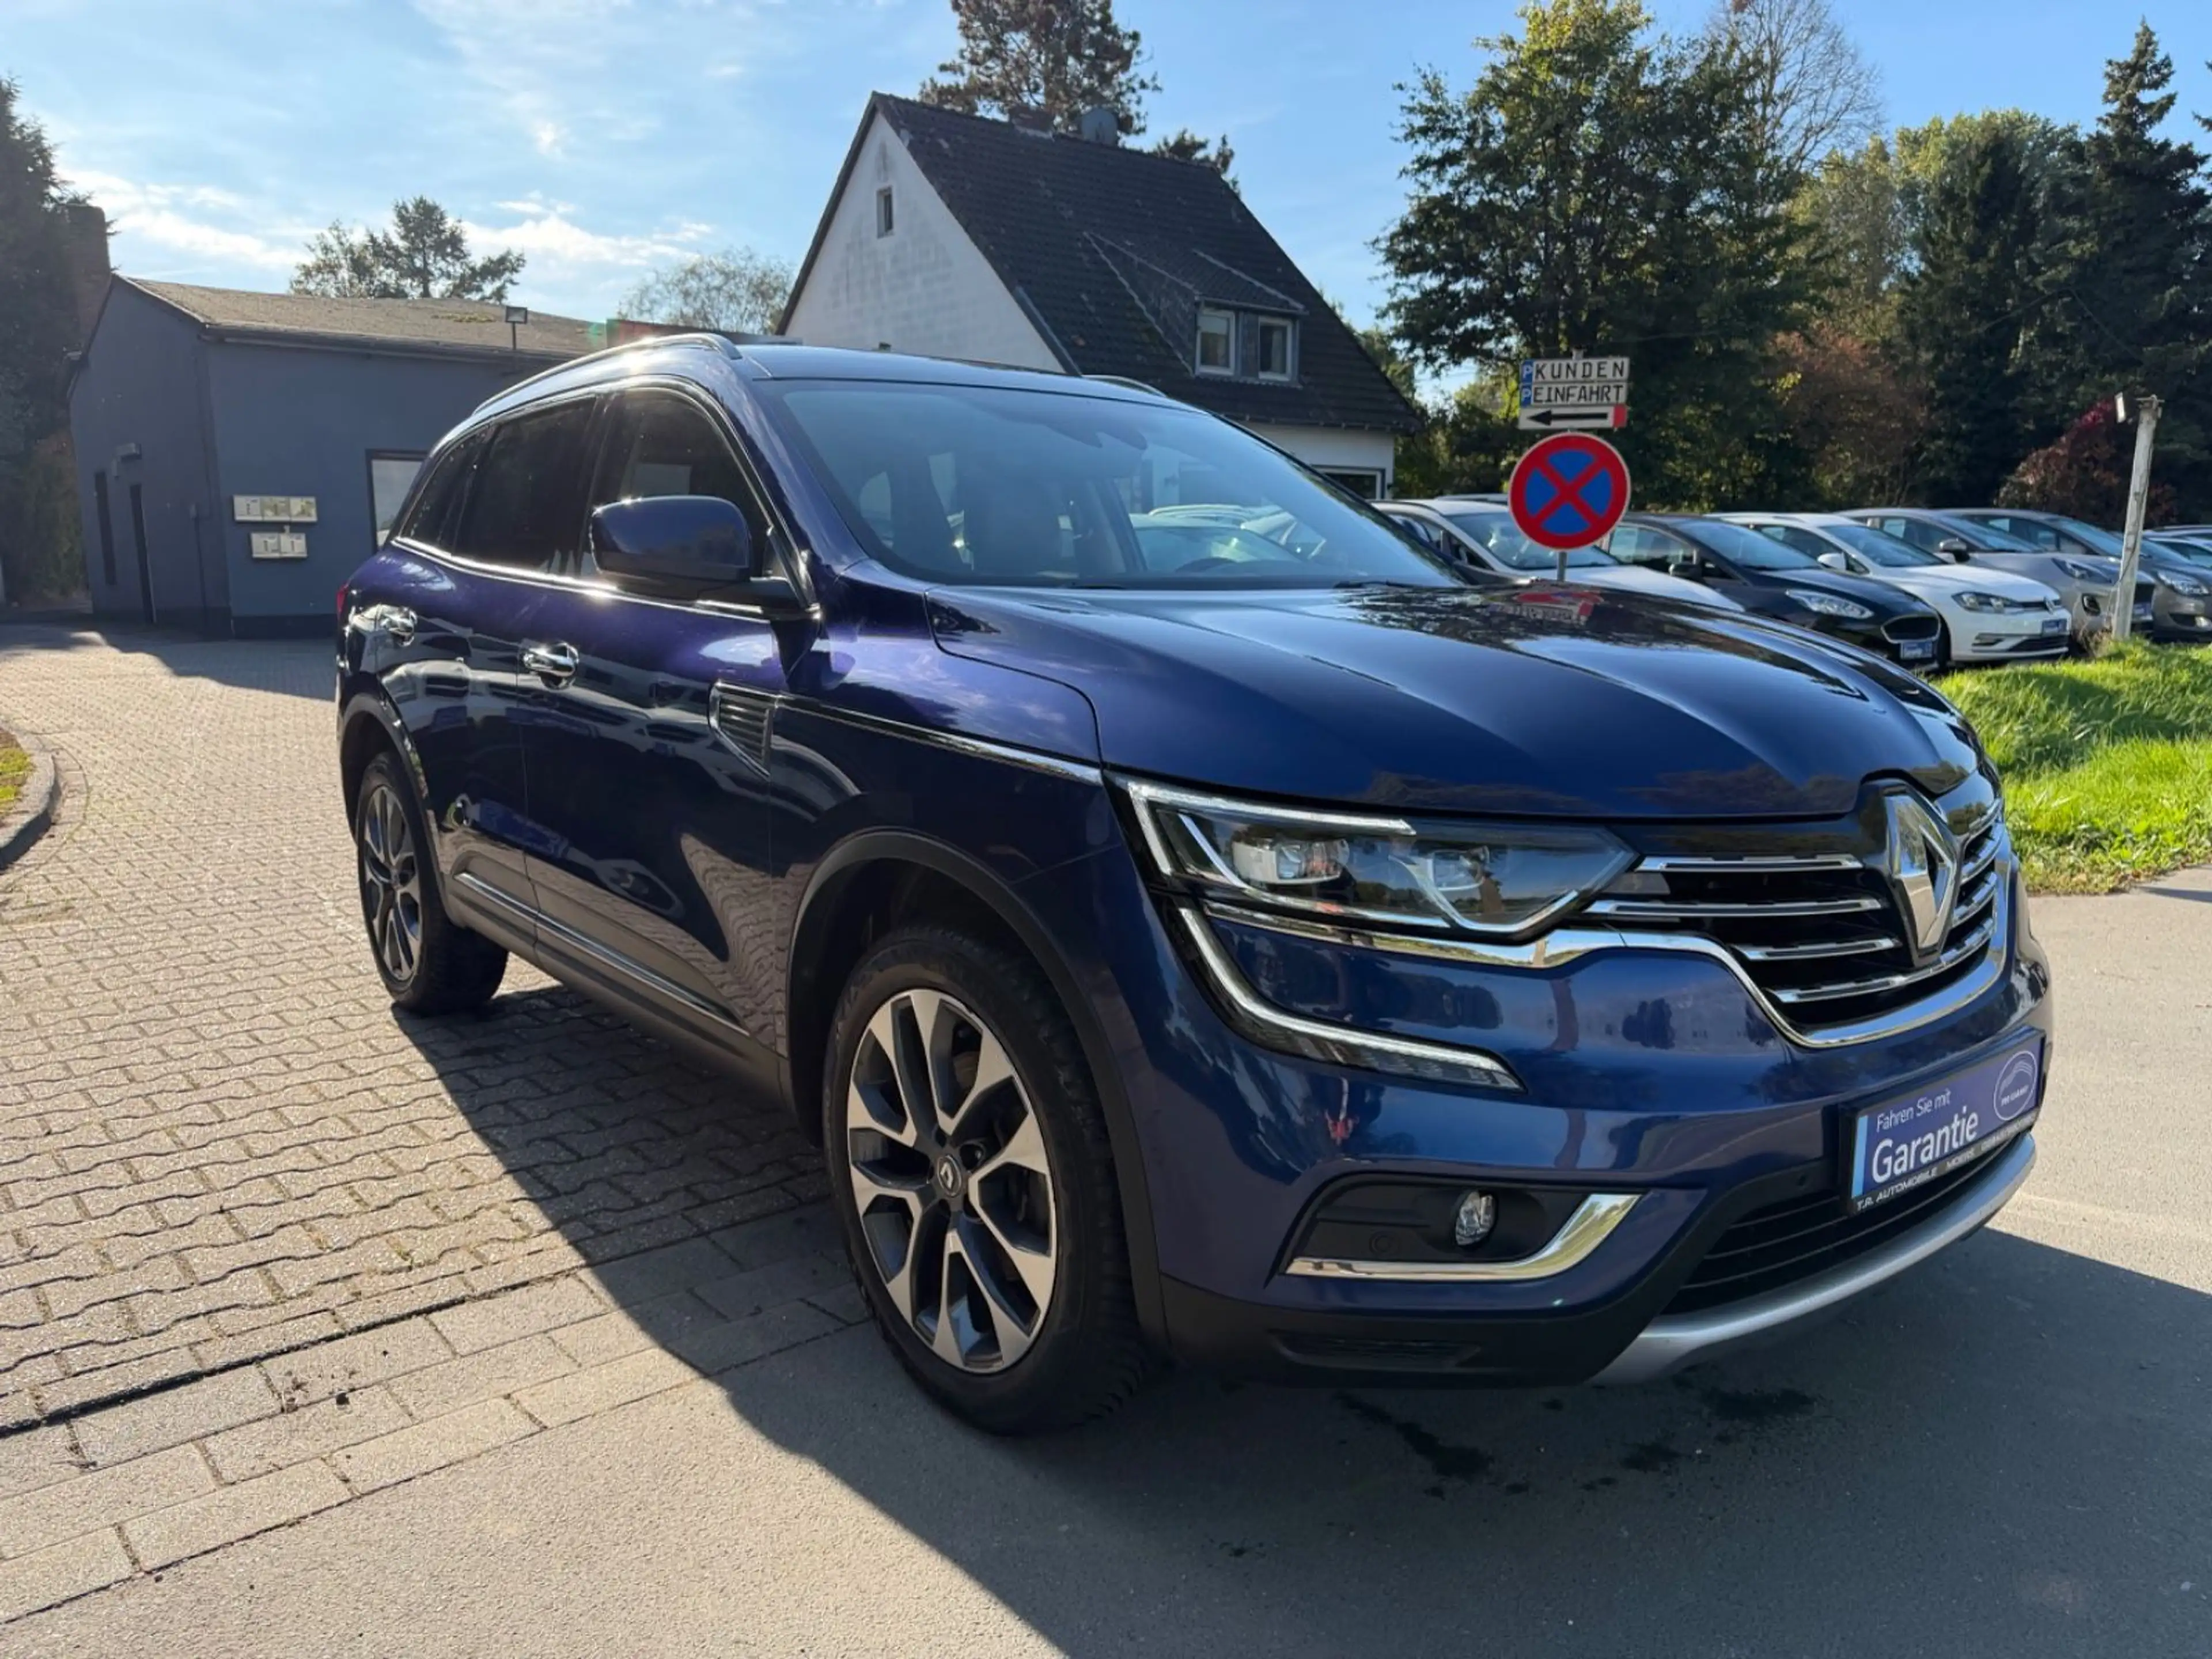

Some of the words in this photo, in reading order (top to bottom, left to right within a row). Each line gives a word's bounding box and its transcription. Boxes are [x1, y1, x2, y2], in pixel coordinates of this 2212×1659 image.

[1522, 365, 1533, 378] P
[1535, 361, 1624, 380] KUNDEN
[1521, 388, 1531, 402] P
[1533, 384, 1624, 403] EINFAHRT
[1876, 1106, 1914, 1133] Fahren
[1916, 1096, 1933, 1117] Sie
[1934, 1088, 1951, 1109] mit
[1872, 1105, 1979, 1184] Garantie
